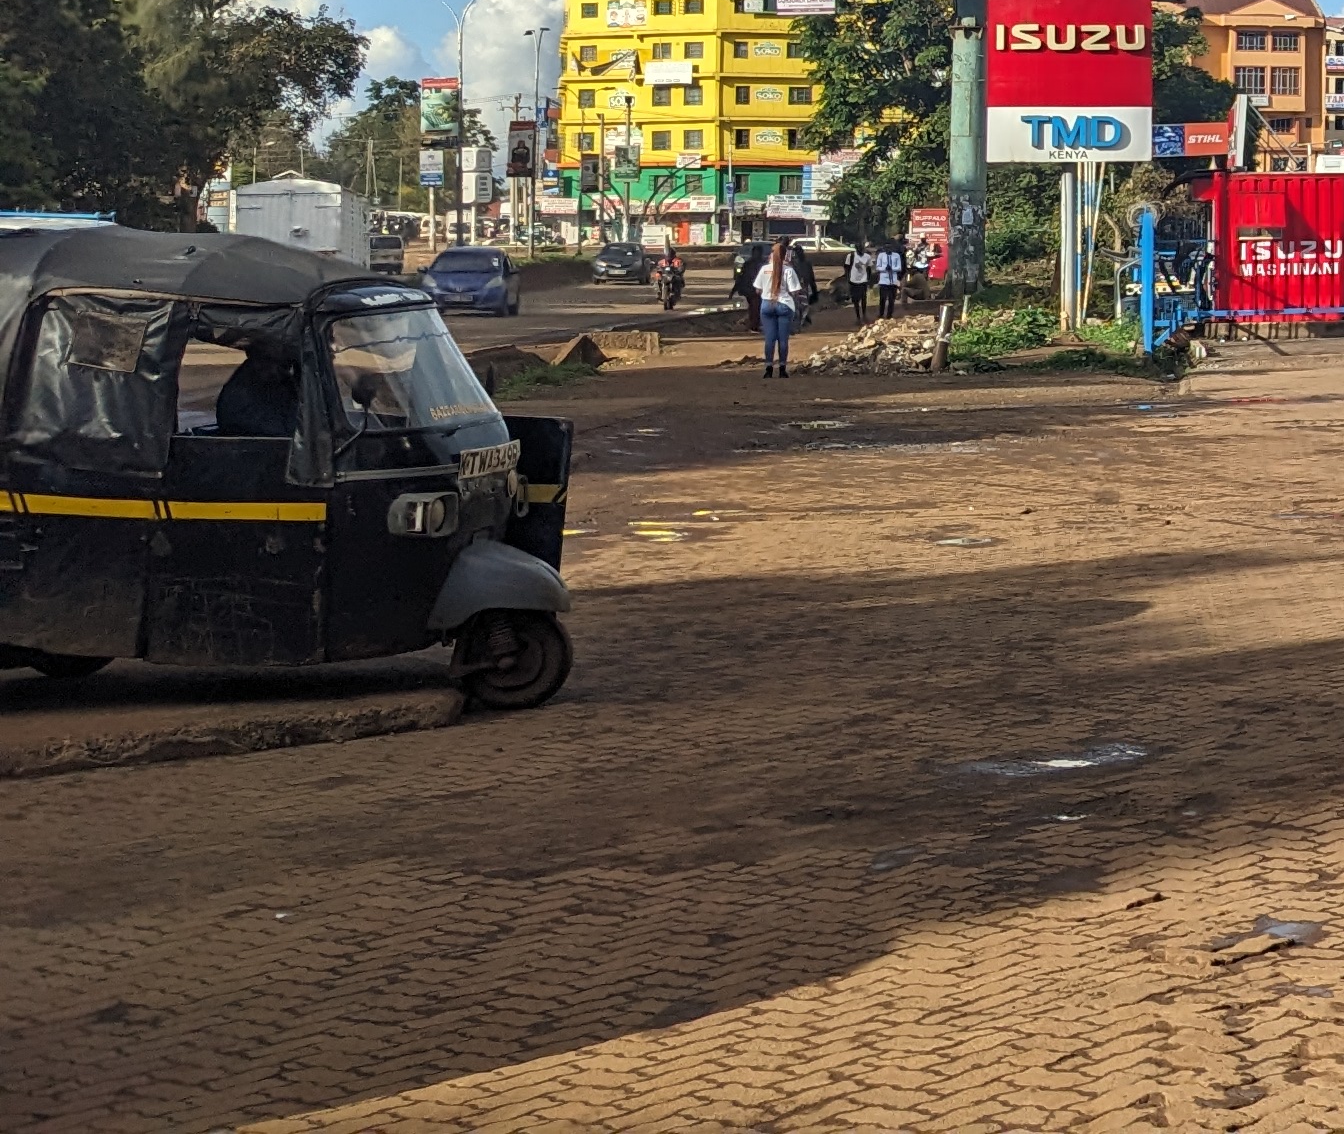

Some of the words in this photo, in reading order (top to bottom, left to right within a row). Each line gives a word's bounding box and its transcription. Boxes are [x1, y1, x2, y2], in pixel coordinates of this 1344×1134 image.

[996, 24, 1146, 51] ISUZU
[756, 91, 782, 100] SOKO
[1020, 115, 1122, 149] TMD
[755, 134, 782, 144] SOKO
[1187, 134, 1223, 144] STIHL
[1048, 151, 1089, 160] KENYA
[1240, 239, 1343, 261] ISUZU
[1241, 261, 1340, 277] MASHINANI
